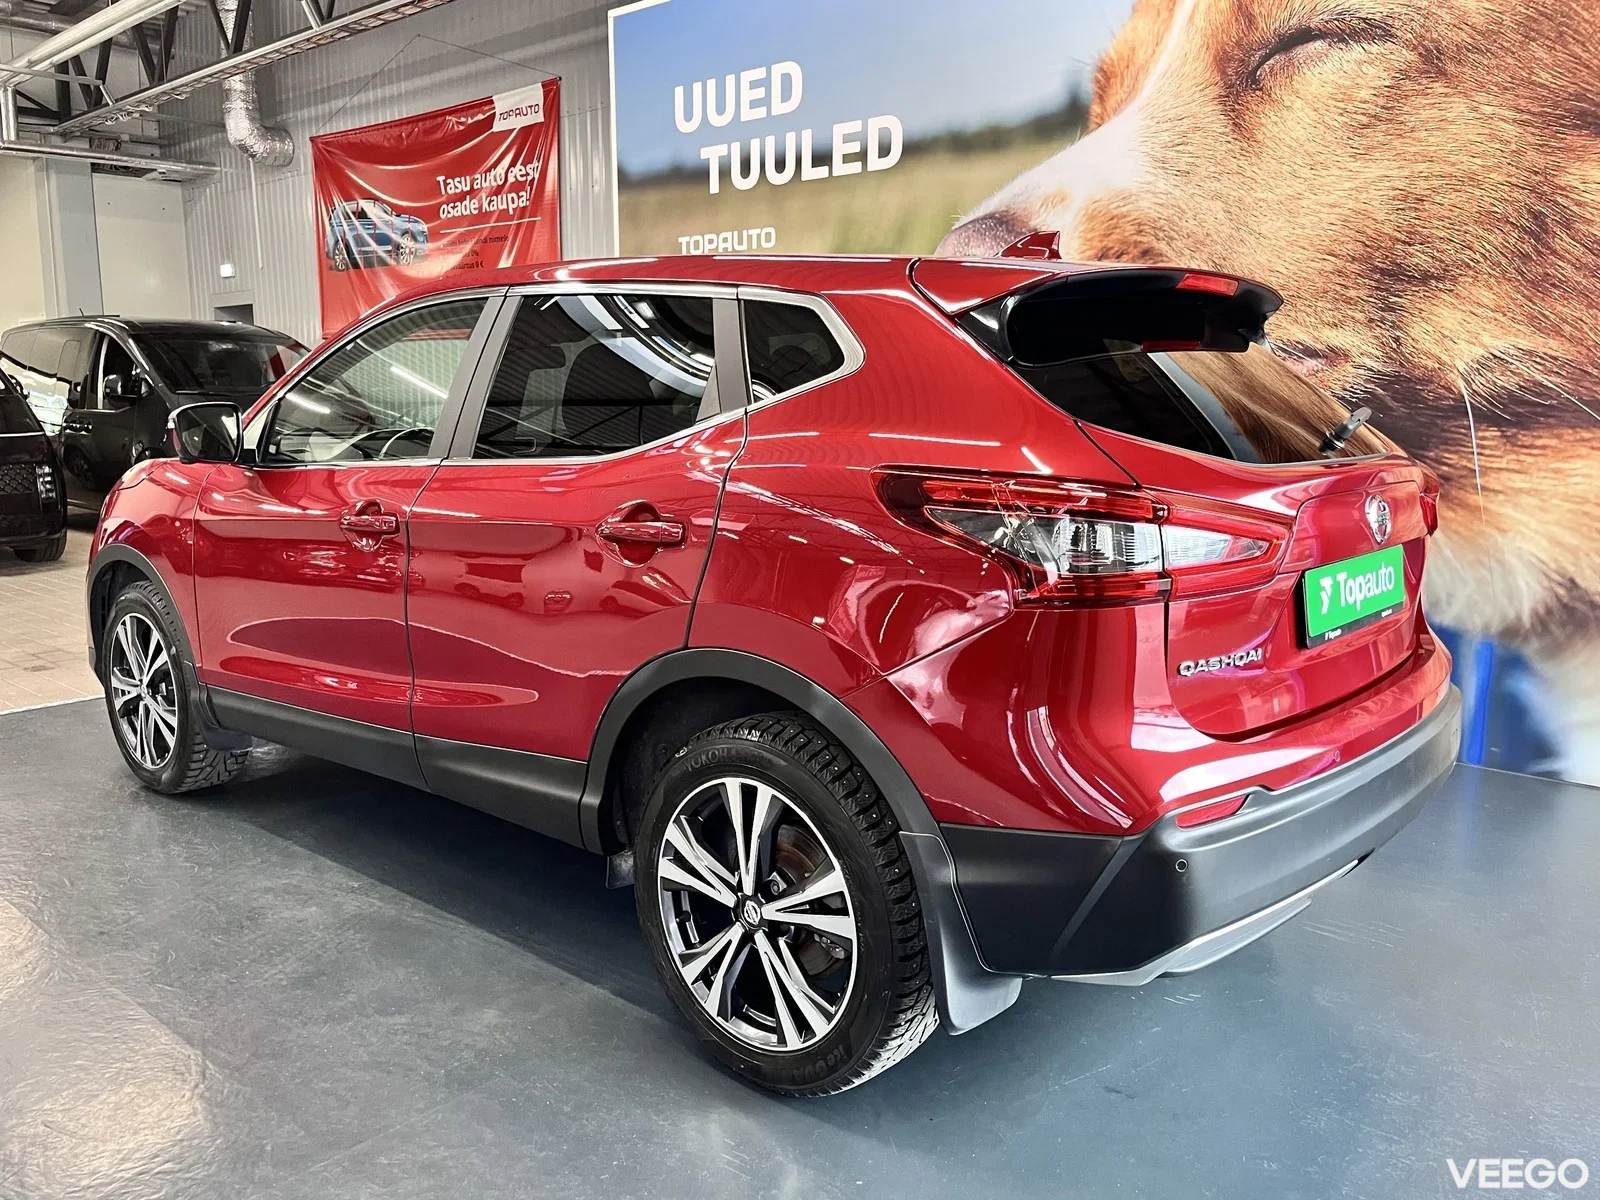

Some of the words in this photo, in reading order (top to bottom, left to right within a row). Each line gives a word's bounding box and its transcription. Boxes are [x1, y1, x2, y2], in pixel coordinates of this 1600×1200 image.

[498, 103, 540, 122] TOPAUTO
[674, 60, 803, 134] UUED
[700, 114, 904, 195] TUULED
[436, 175, 470, 195] Tasu
[473, 165, 506, 189] auto
[508, 160, 540, 183] eest
[440, 195, 479, 219] osade
[481, 185, 531, 215] kaupa!
[677, 226, 776, 256] TOPAUTO
[1336, 562, 1395, 611] Topauto
[1179, 647, 1263, 677] QASHQAI
